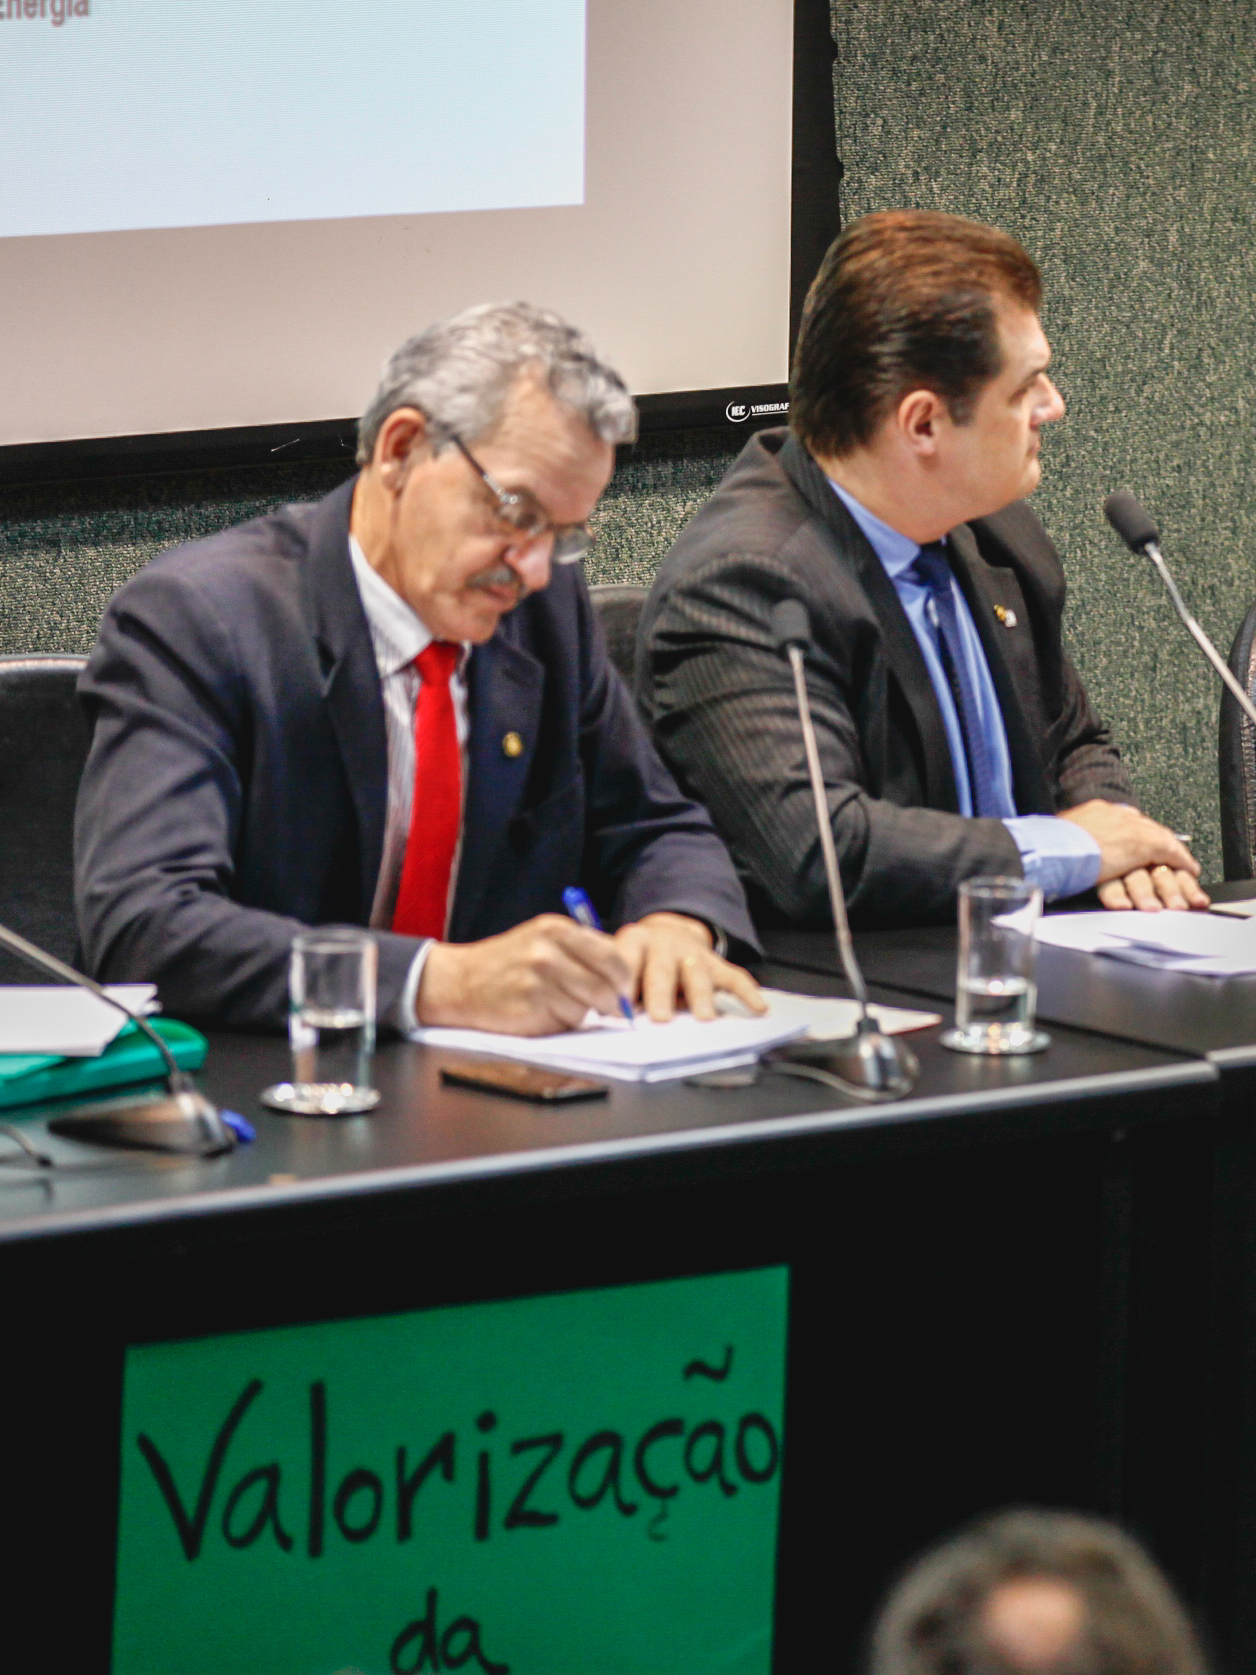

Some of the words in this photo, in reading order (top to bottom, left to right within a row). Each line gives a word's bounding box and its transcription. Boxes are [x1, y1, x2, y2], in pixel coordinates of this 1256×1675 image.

[731, 405, 746, 417] IEC
[137, 1344, 780, 1562] Valorização
[390, 1587, 510, 1675] da
